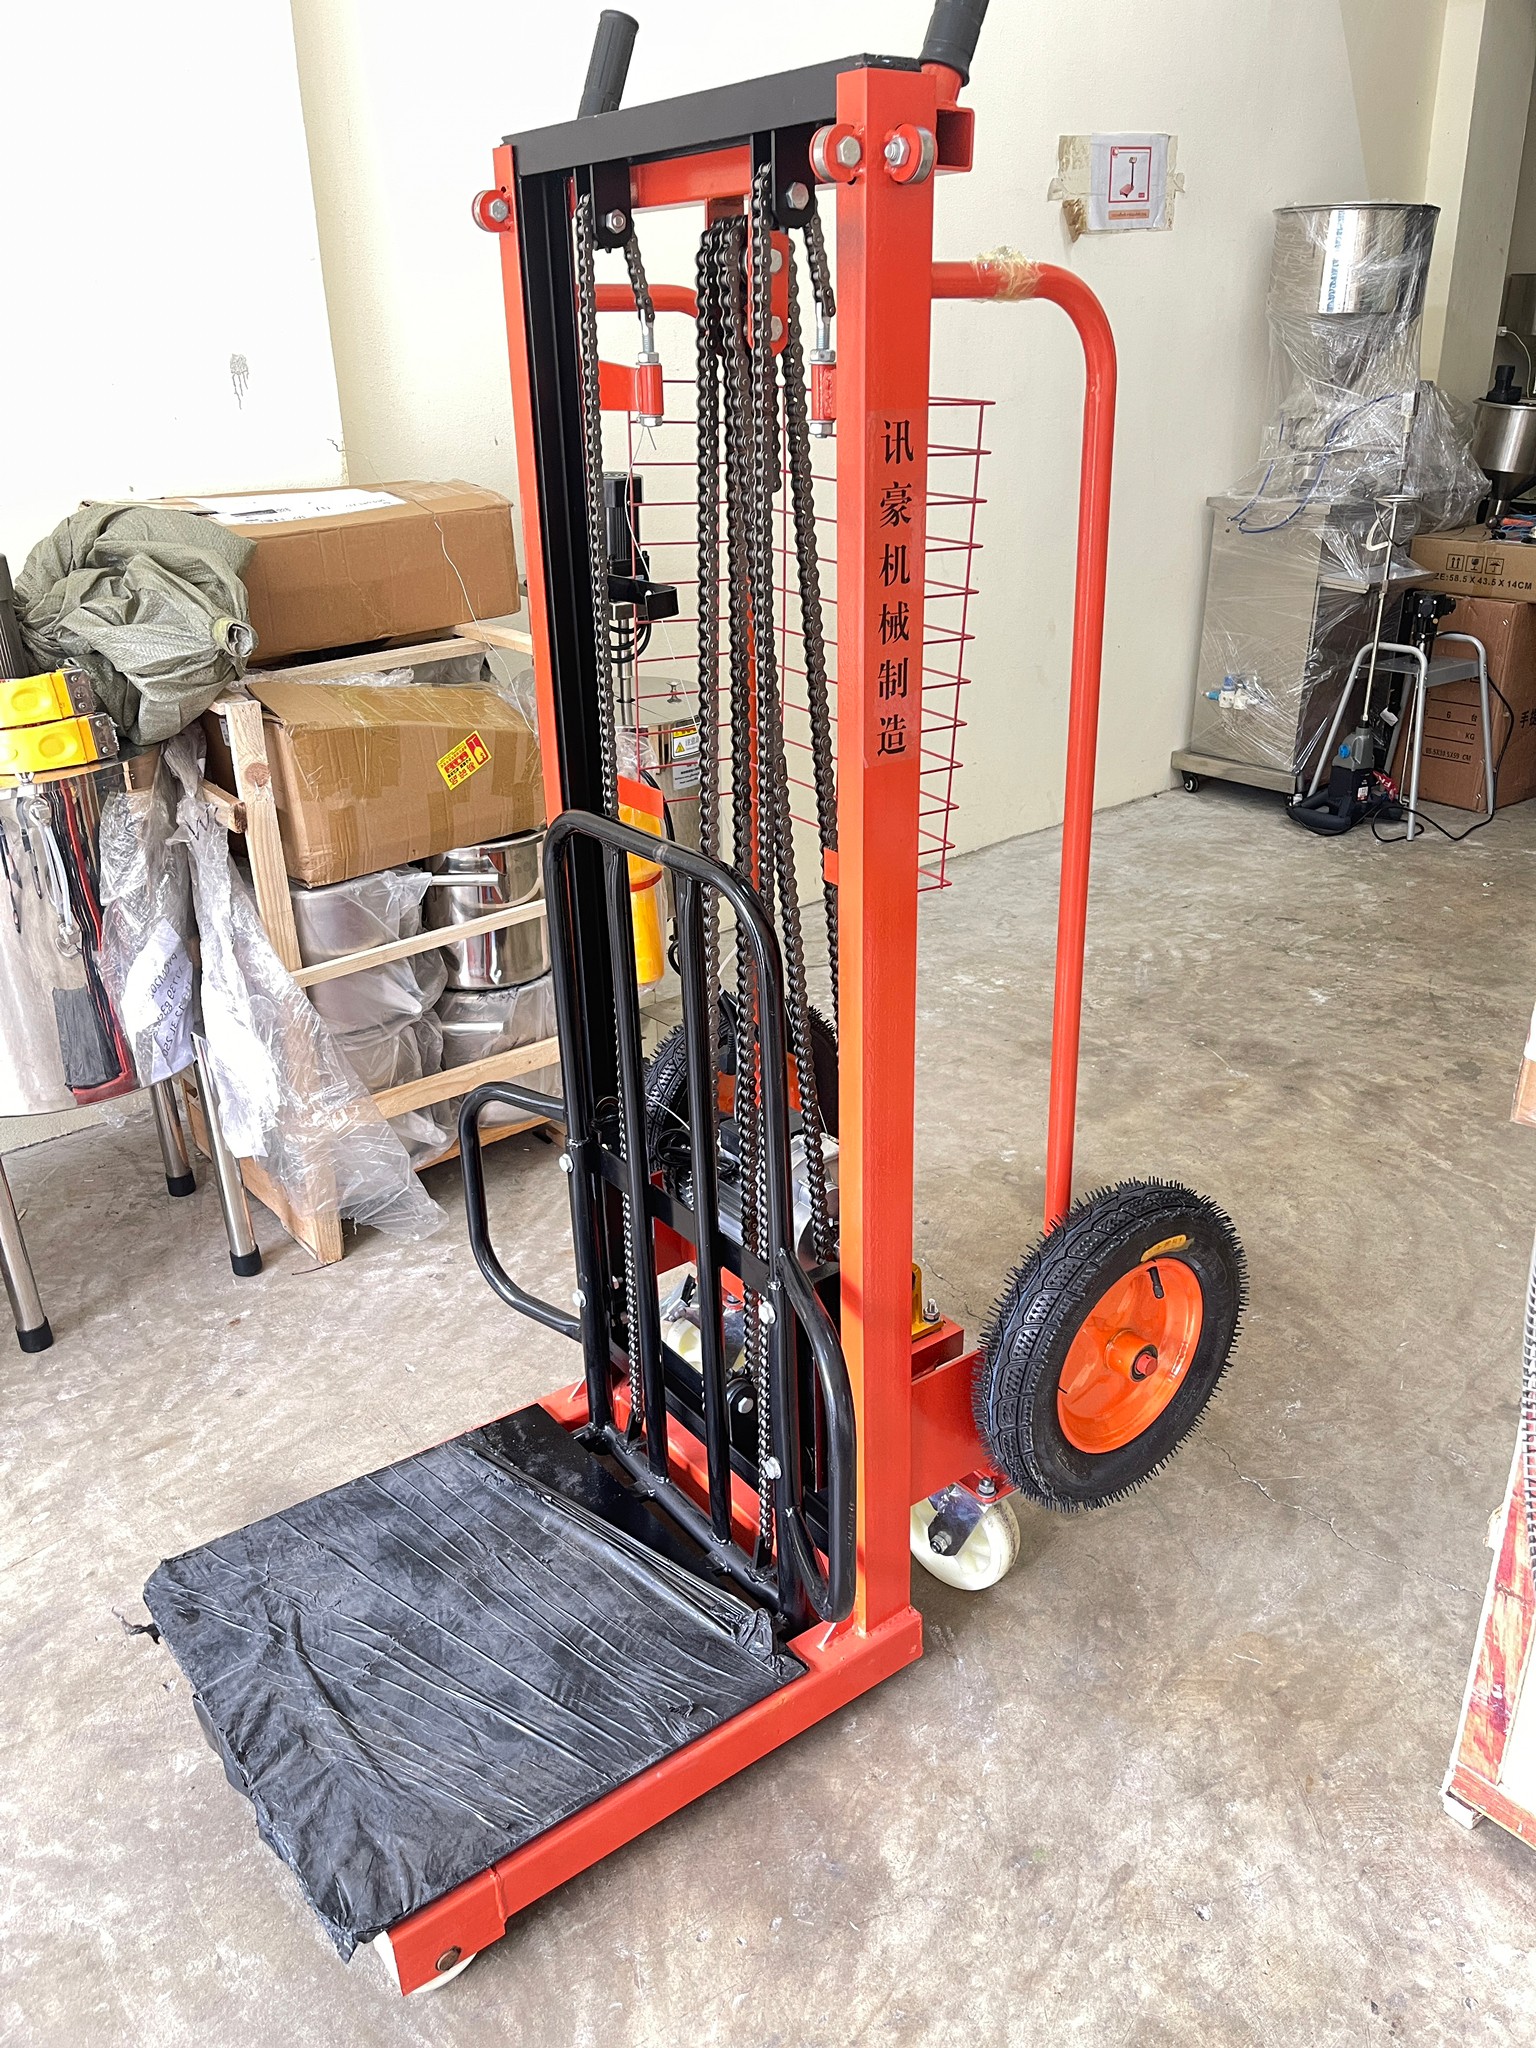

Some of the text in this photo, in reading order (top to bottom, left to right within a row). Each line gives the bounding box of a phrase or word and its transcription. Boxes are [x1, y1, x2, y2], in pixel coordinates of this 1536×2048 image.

[877, 419, 914, 756] 讯豪机械制造
[1477, 577, 1497, 586] 43.5
[1498, 579, 1505, 587] X
[1507, 581, 1532, 590] 14CM
[1465, 732, 1475, 740] KG
